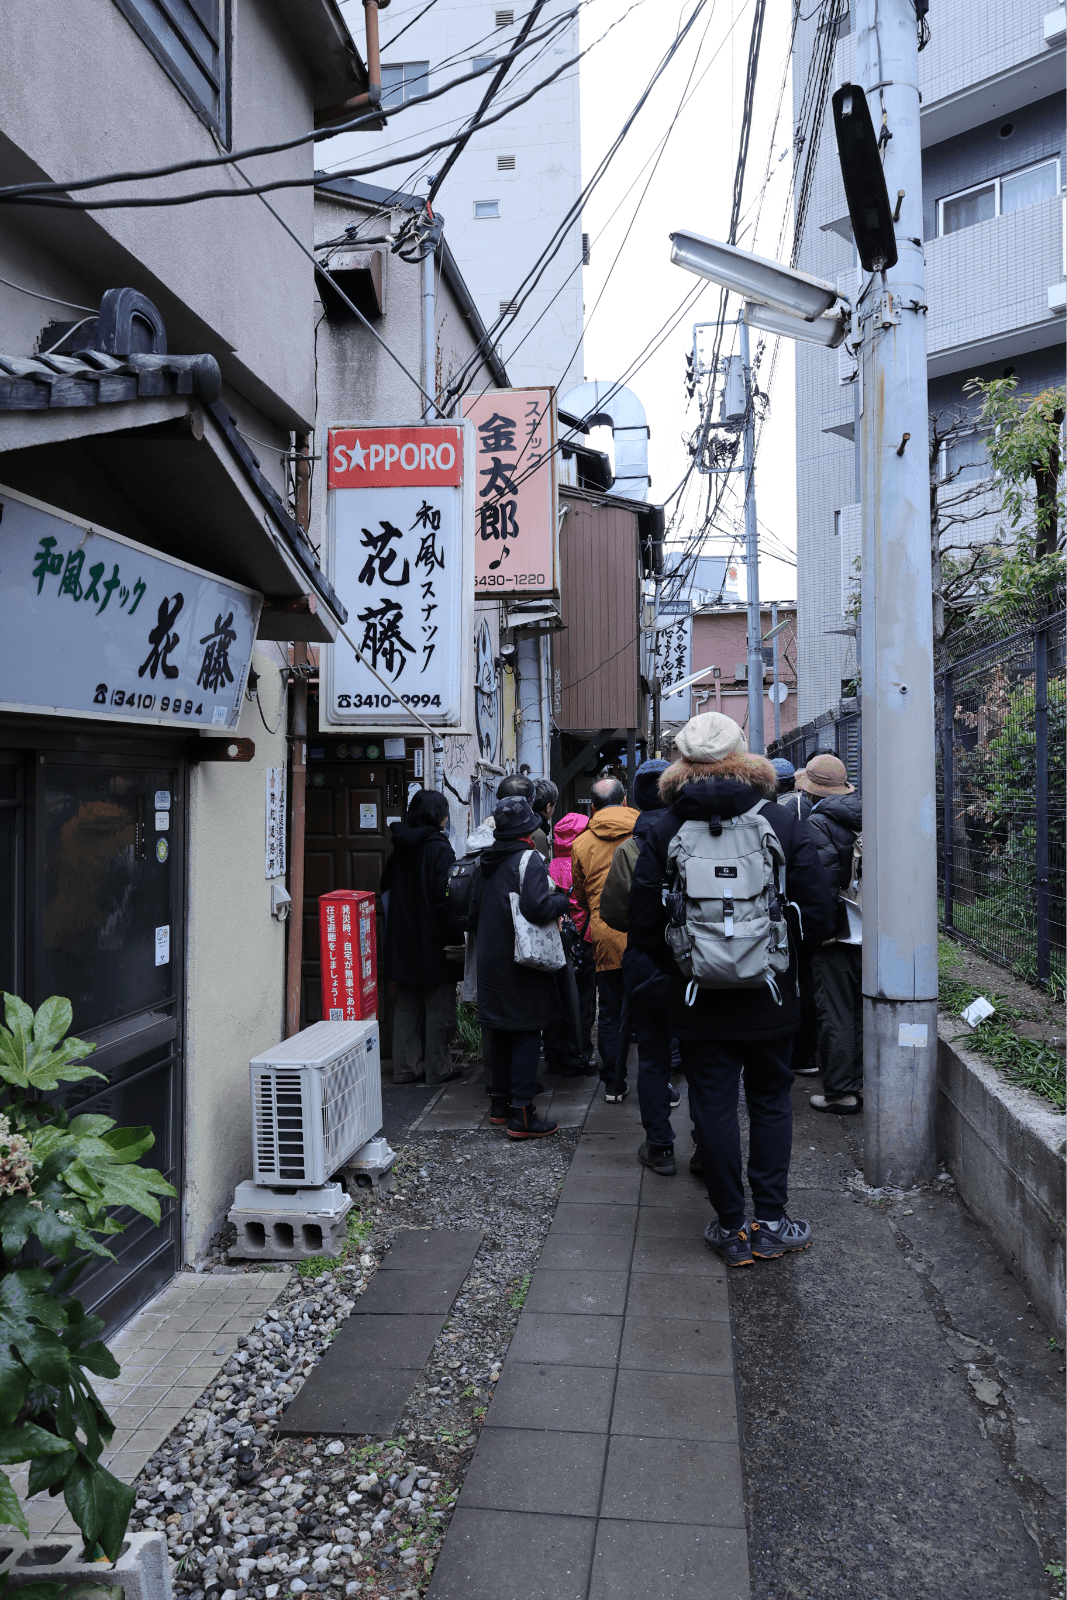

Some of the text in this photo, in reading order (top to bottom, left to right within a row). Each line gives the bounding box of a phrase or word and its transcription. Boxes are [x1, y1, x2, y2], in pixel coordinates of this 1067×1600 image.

[478, 412, 520, 541] 金太郎
[524, 401, 543, 470] スナック
[32, 535, 147, 616] 和風スナック
[355, 521, 417, 684] 花藤
[409, 500, 445, 673] 和風スナック
[138, 592, 237, 694] 花藤
[353, 693, 442, 708] 3410-9994
